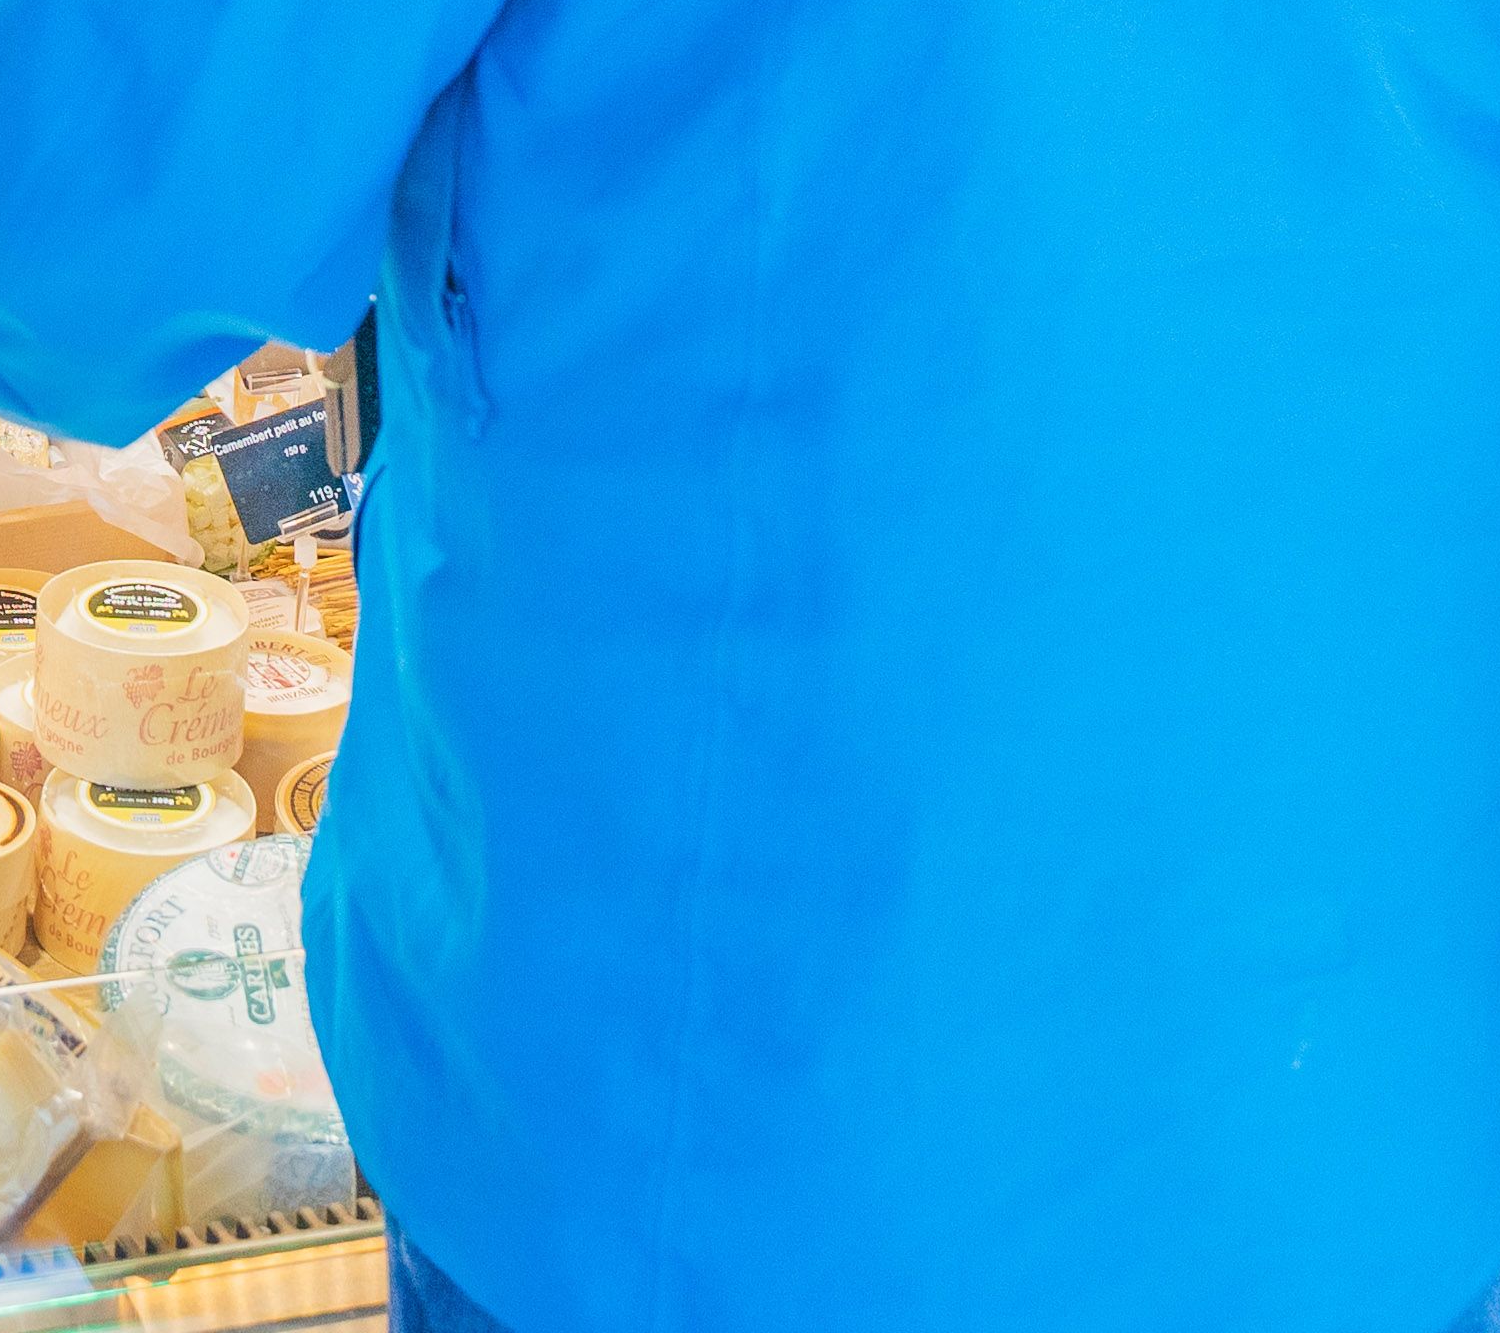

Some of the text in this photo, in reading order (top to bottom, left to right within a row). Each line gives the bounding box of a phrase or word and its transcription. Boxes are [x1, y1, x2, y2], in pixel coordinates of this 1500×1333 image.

[213, 427, 275, 457] Camembert
[273, 419, 299, 439] petit
[298, 415, 312, 429] au
[282, 444, 299, 458] 150
[308, 484, 343, 505] 119,-
[175, 665, 219, 704] Le
[165, 750, 186, 766] de
